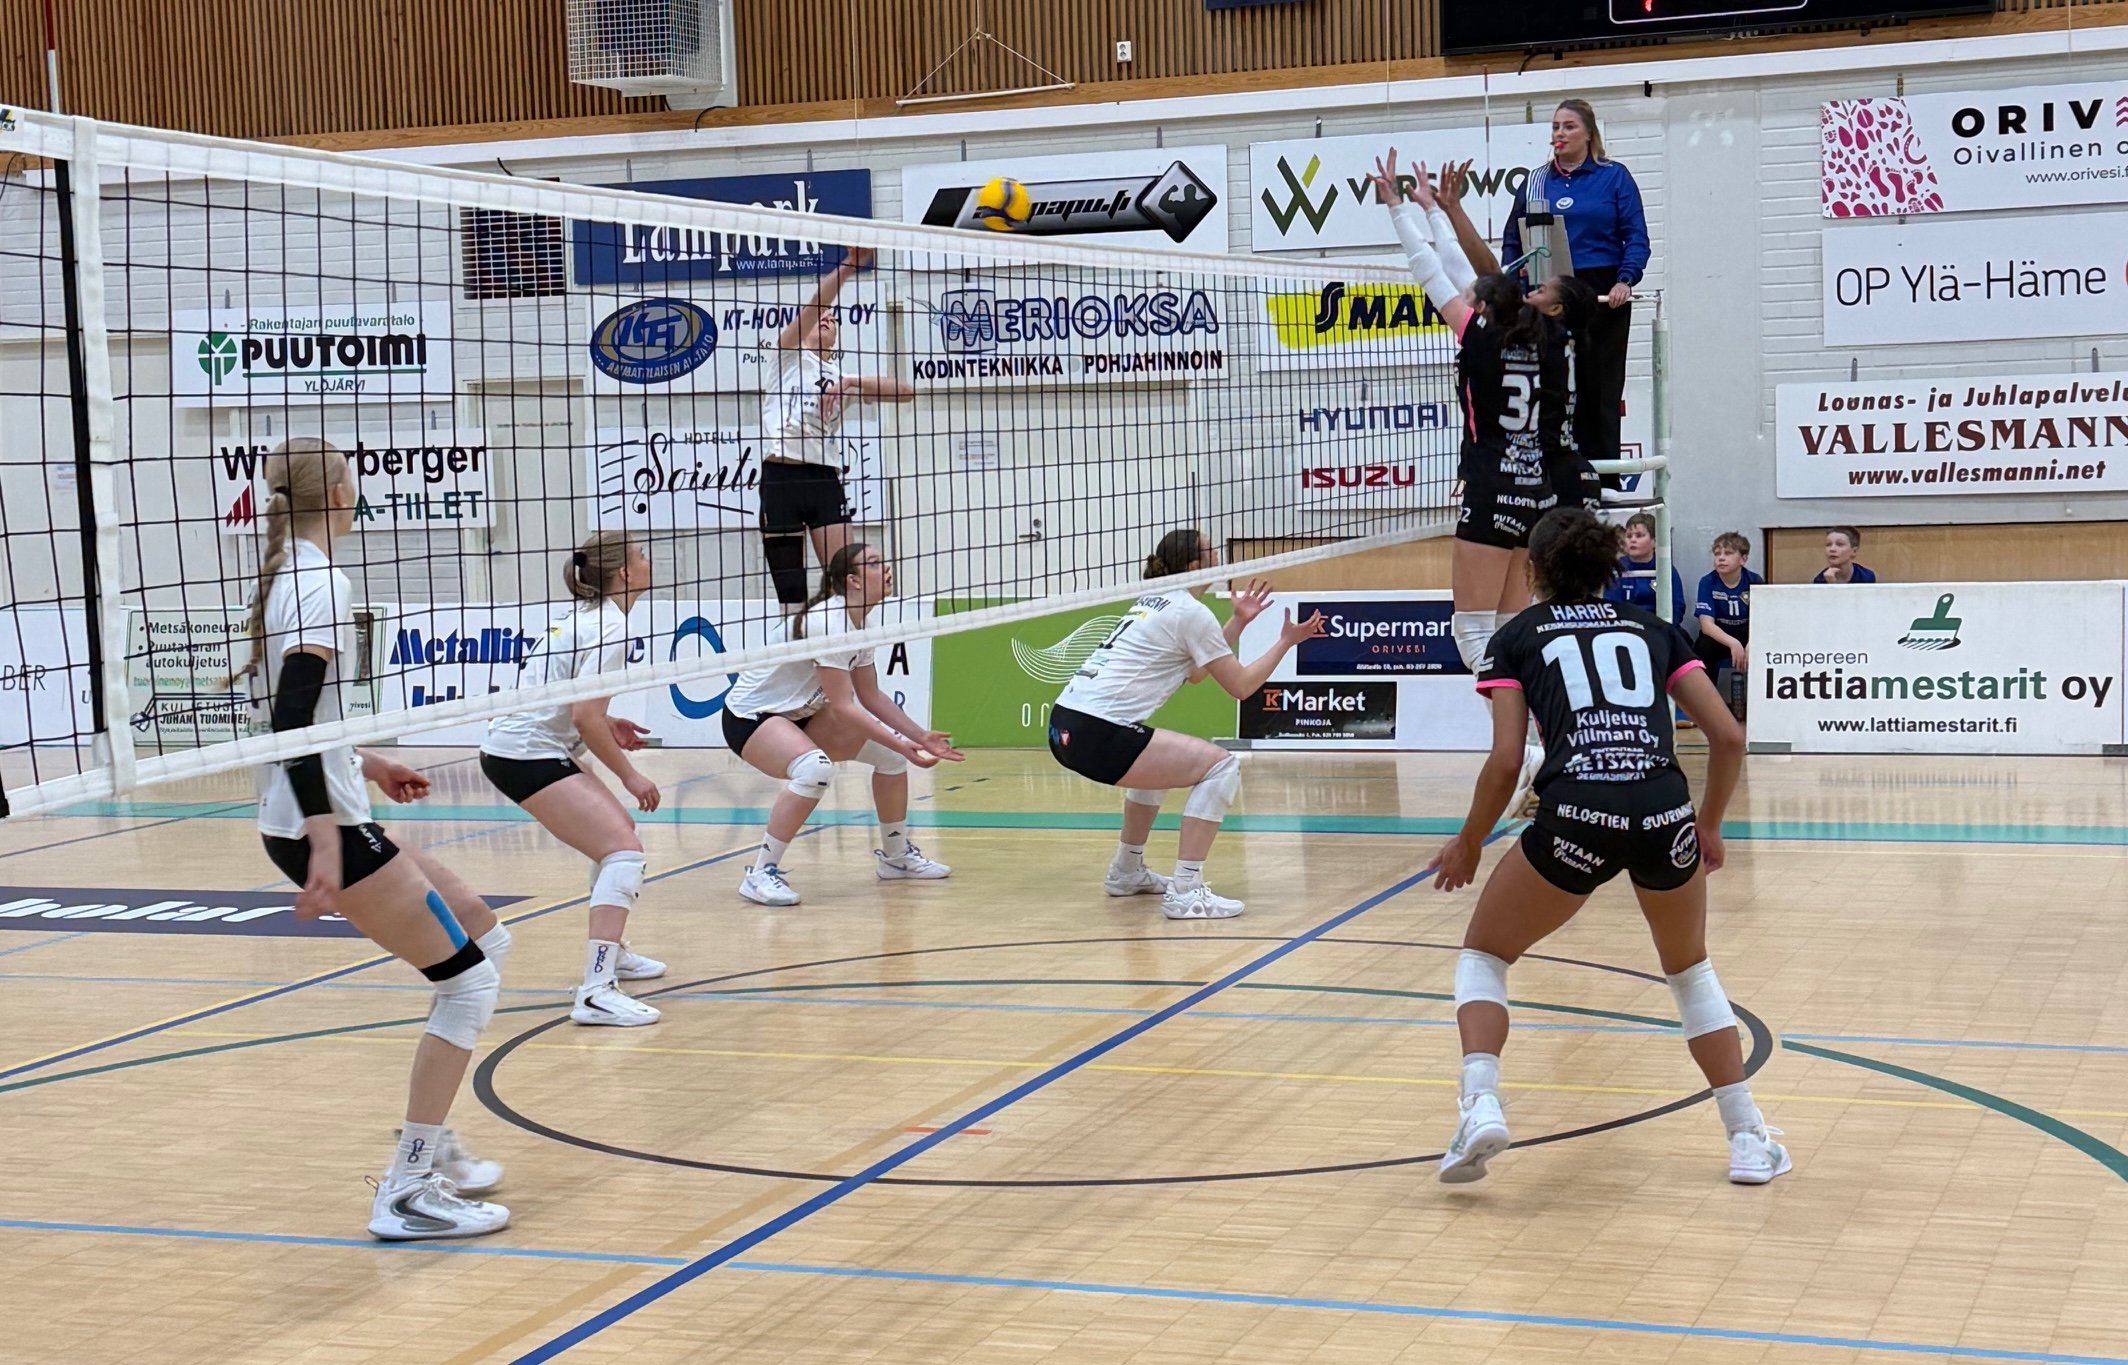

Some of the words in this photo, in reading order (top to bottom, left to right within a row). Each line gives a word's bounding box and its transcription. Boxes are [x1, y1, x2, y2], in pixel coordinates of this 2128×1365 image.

[1953, 141, 2102, 165] Oivallinen
[1836, 267, 1890, 306] OP
[1901, 259, 2107, 303] Ylä-Häme
[250, 319, 322, 331] Rakentajan
[849, 303, 876, 325] OY
[945, 290, 1220, 348] MERIOKSA
[241, 334, 427, 369] PUUTOIMI
[913, 355, 1064, 379] KODINTEKNIIKKA
[1085, 350, 1223, 373] POHJAHINNOIN
[304, 379, 366, 392] YLÖJÄRVI
[1818, 390, 1916, 412] Lounas-
[1927, 387, 1952, 413] ja
[1300, 404, 1448, 432] HYUNDAI
[1798, 415, 2128, 455] VALLESMANN
[221, 441, 488, 483] Wiberger
[1849, 460, 2106, 485] www.vallesmanni.net
[1302, 465, 1416, 489] ISUZU
[1550, 603, 1618, 621] HARRIS
[1728, 600, 1739, 616] 11
[1372, 645, 1426, 654] ORIVESI
[1766, 651, 1868, 667] tampereen
[1541, 632, 1655, 712] 10
[1766, 667, 2046, 701] lattiamestarit
[2061, 675, 2113, 708] oy
[1282, 688, 1366, 712] Market
[160, 714, 195, 725] JUHAN
[1576, 709, 1647, 728] Kuljetus
[1817, 717, 2017, 734] www.lattiamestarit.fi
[1566, 728, 1636, 748] Villman
[1638, 729, 1659, 749] Oy
[1557, 804, 1630, 831] NELOSTIEN
[1553, 836, 1605, 867] PUTAAN
